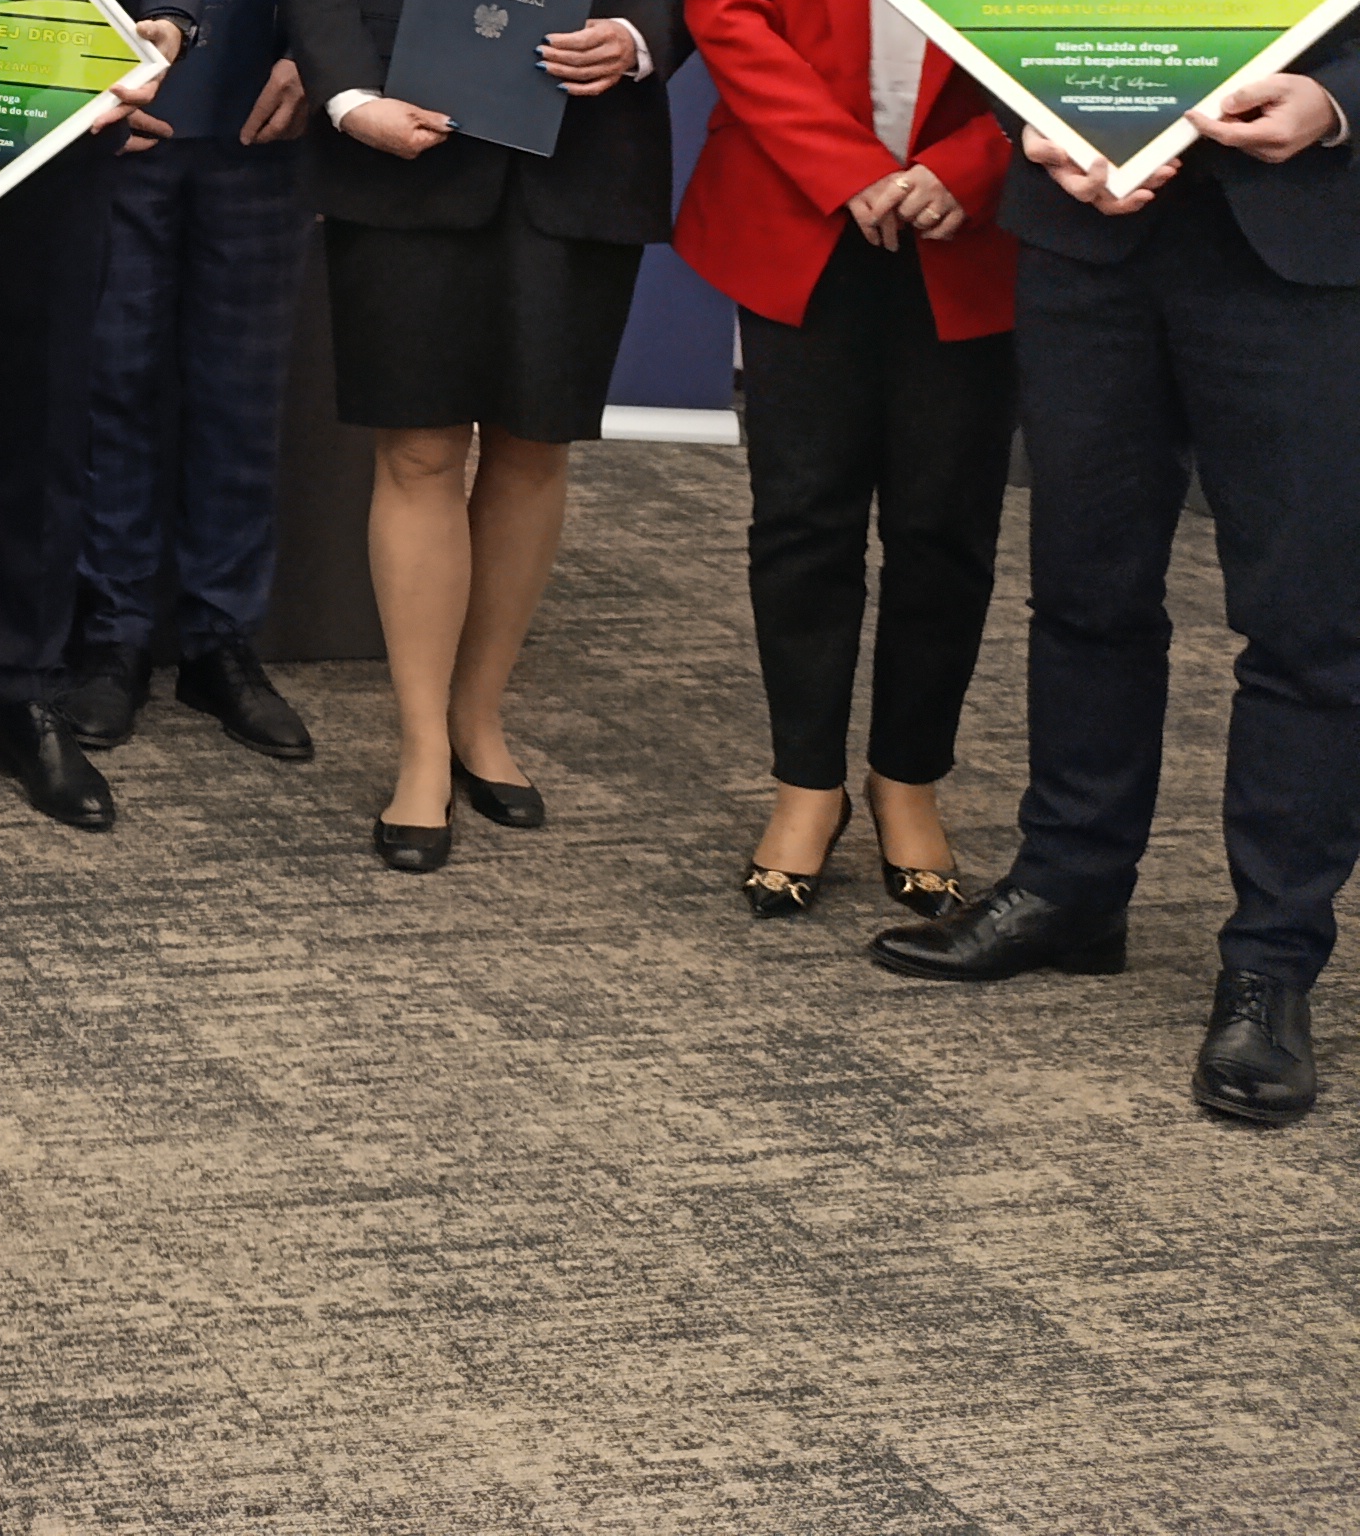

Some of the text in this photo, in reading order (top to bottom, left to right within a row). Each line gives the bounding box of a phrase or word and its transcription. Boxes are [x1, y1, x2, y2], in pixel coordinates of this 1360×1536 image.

[982, 5, 1013, 16] DLA
[1017, 4, 1093, 16] POWIATU
[28, 28, 93, 47] DROGI
[1055, 41, 1179, 55] Niech każda droga
[1021, 56, 1219, 69] prowadzi bezpiecznie do celu!
[9, 107, 22, 116] do
[23, 108, 48, 119] celu!
